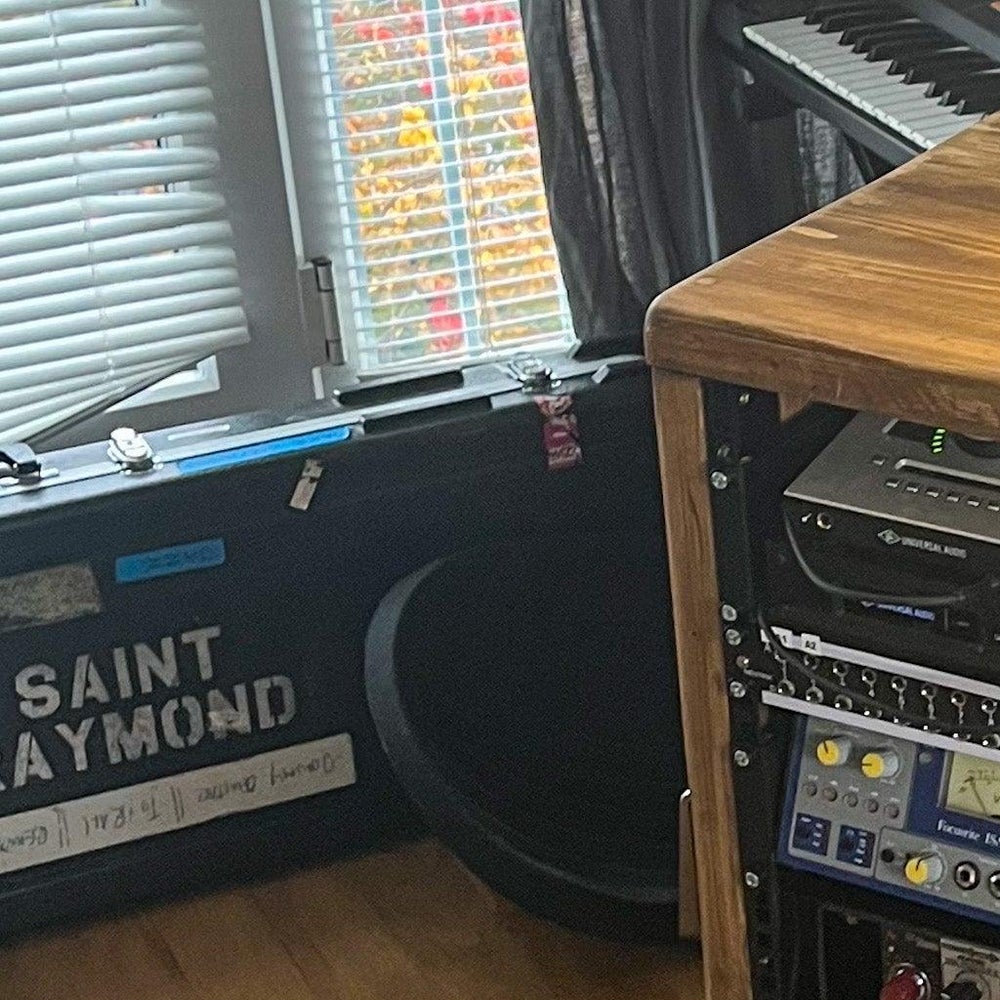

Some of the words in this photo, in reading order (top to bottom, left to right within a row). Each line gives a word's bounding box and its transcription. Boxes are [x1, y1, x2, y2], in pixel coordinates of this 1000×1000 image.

[15, 625, 221, 719] SAINT
[0, 674, 297, 791] AYMOND
[936, 819, 981, 841] Focusrite
